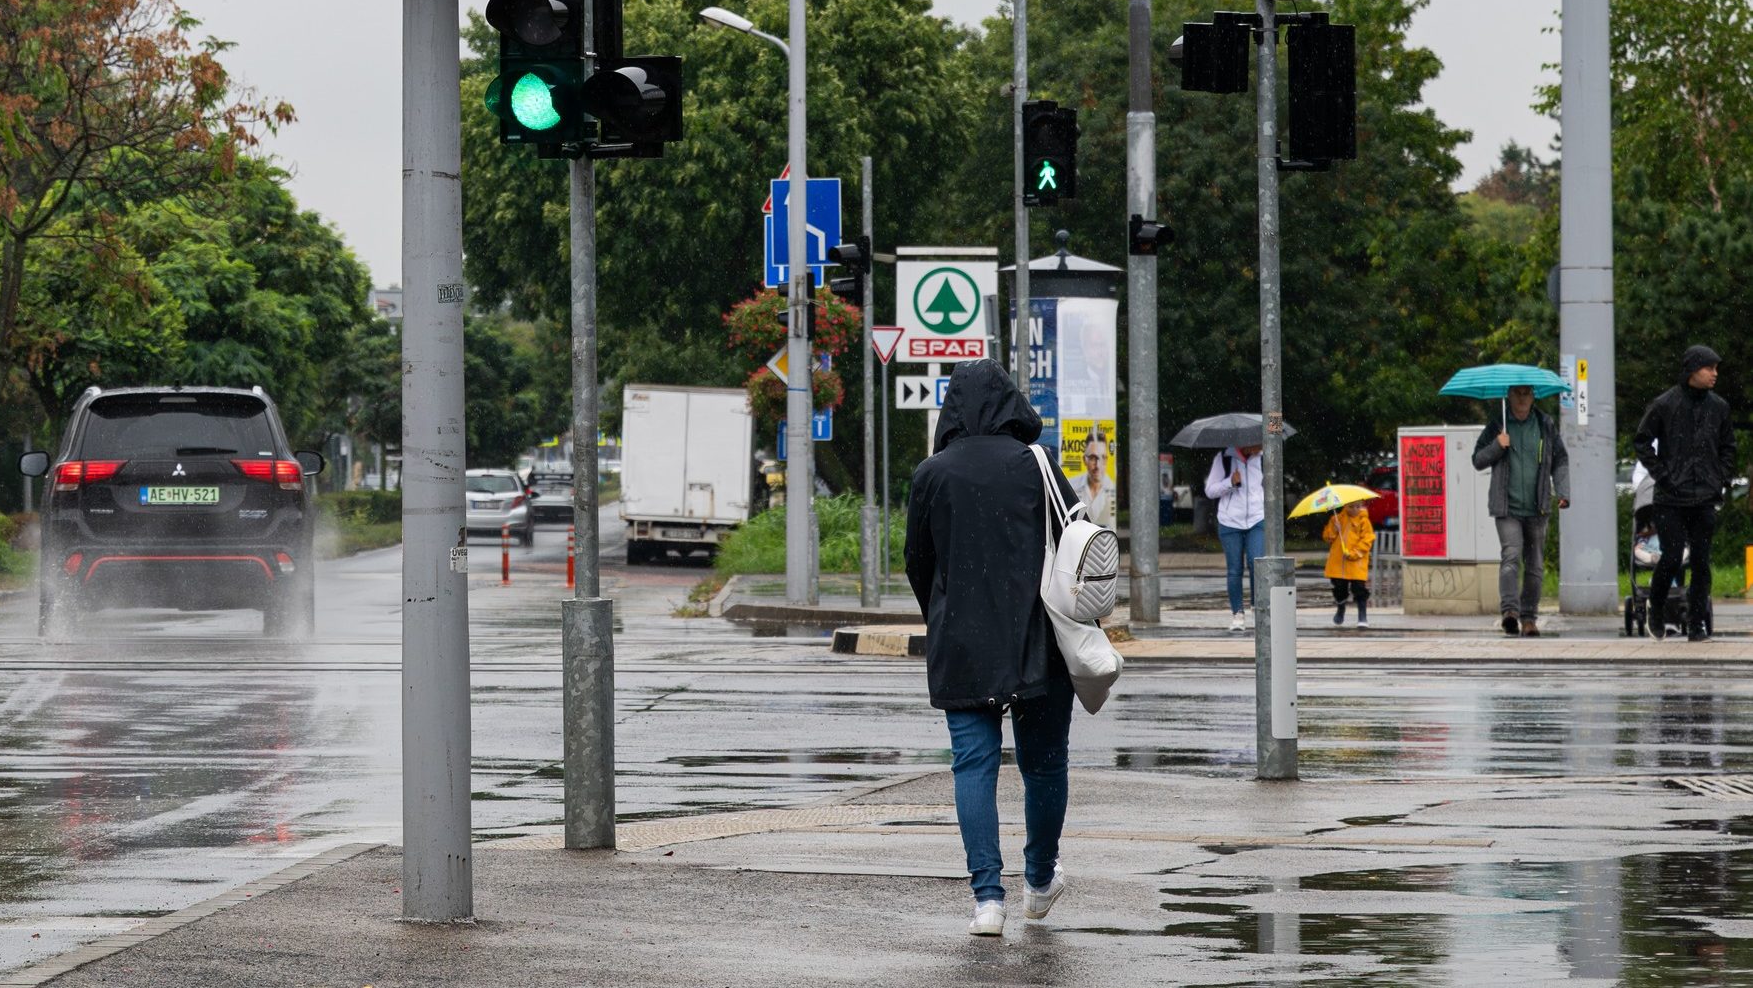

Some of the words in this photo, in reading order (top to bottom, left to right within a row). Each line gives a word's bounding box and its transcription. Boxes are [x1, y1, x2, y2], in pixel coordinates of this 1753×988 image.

[911, 340, 982, 356] SPAR
[150, 488, 166, 501] AE
[172, 488, 217, 501] HV-521
